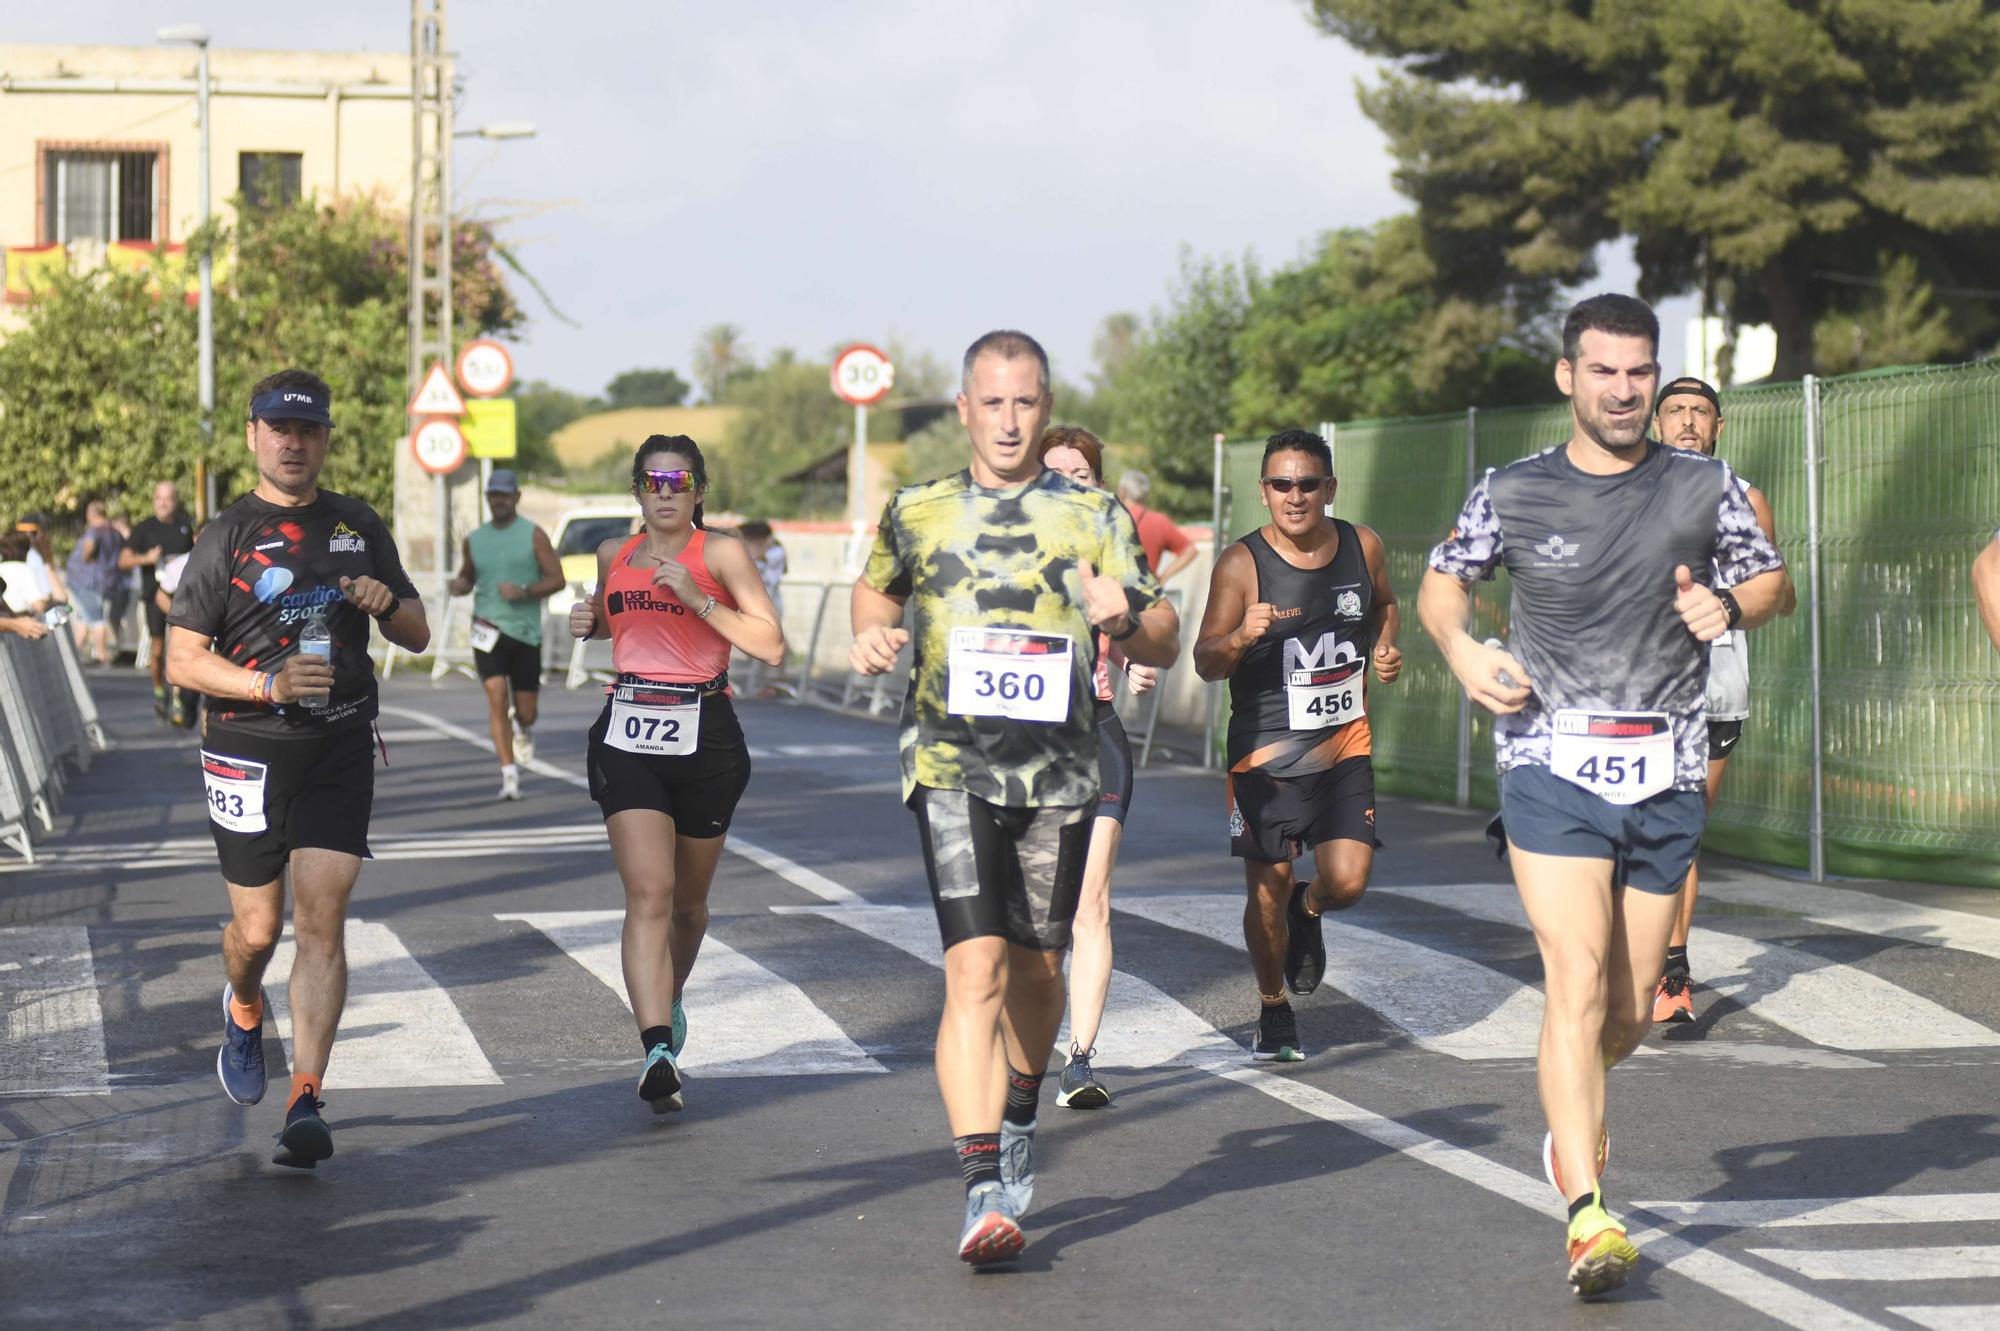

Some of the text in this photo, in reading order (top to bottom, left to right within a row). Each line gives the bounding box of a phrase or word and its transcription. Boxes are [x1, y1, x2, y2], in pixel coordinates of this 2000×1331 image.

[847, 363, 879, 386] 30
[624, 590, 651, 604] pan
[626, 600, 685, 616] moreno
[279, 602, 328, 625] sport
[974, 669, 1045, 702] 360
[1306, 689, 1353, 717] 456
[625, 716, 680, 742] 072
[635, 743, 664, 751] AMANDA
[1576, 755, 1647, 785] 451
